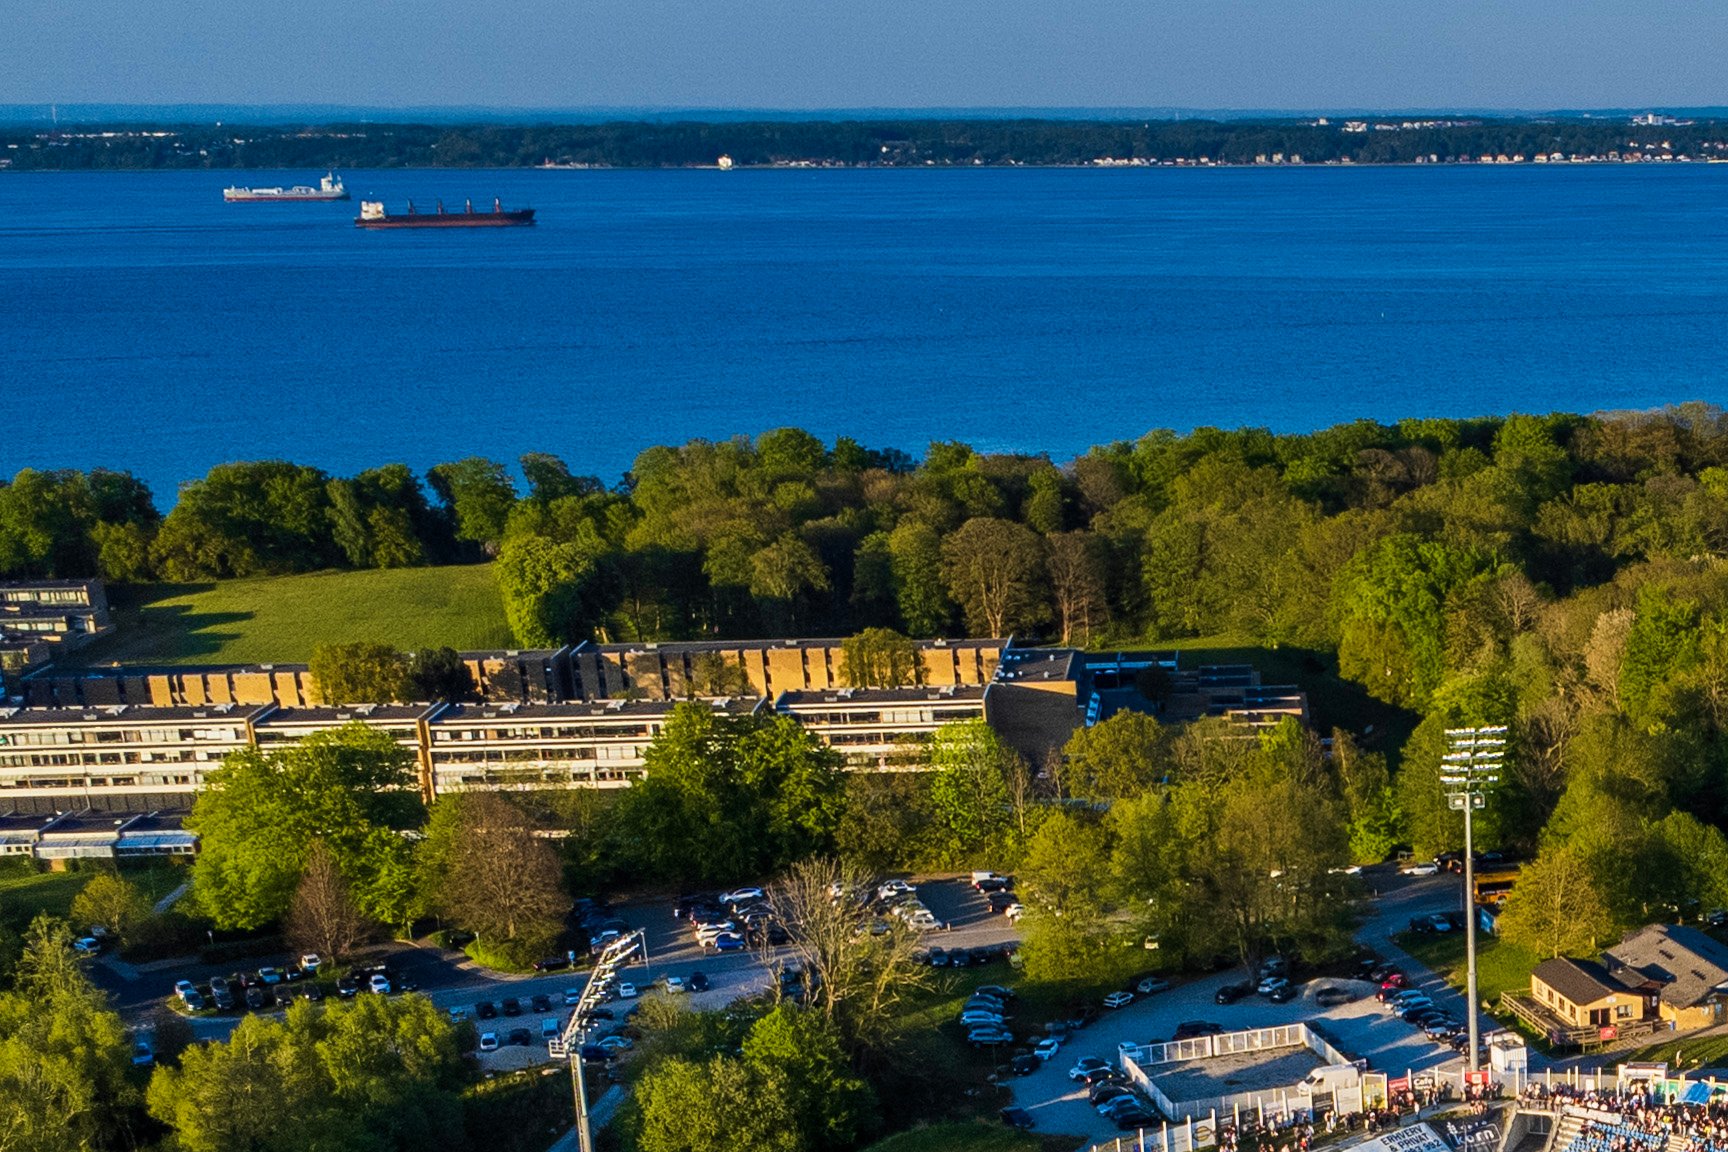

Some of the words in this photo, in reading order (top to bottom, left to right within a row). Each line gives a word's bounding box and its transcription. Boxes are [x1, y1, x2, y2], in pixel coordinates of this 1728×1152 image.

[1381, 1125, 1424, 1146] ERHVERV
[1398, 1132, 1431, 1150] PRIVAT
[1423, 1138, 1443, 1152] 992
